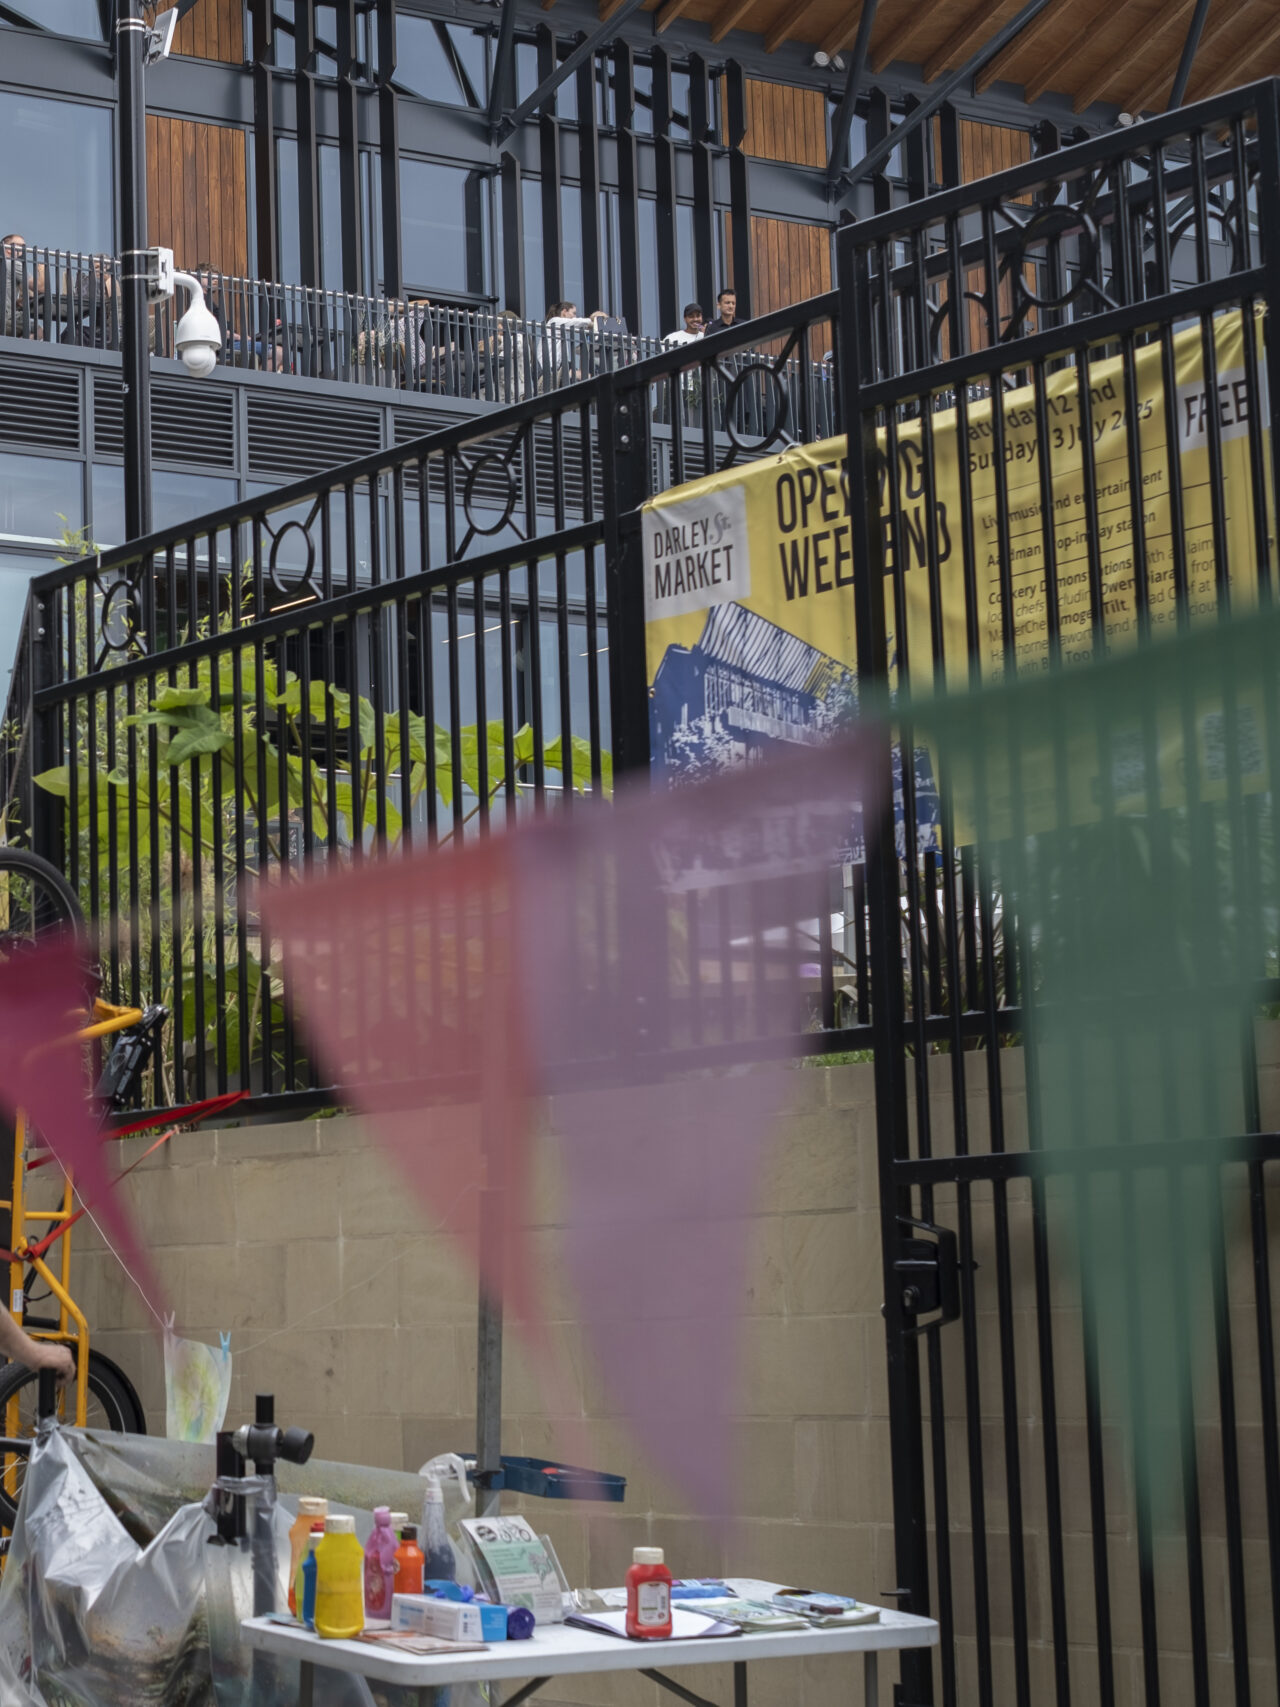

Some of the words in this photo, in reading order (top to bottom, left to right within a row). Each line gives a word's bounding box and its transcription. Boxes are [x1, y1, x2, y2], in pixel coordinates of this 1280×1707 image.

[1075, 378, 1117, 408] nd
[965, 440, 1038, 473] Suday
[1068, 418, 1107, 450] Jy
[1111, 399, 1153, 432] 225
[776, 439, 927, 534] OPEG
[982, 510, 1008, 529] Liv
[1048, 494, 1070, 512] nd
[654, 518, 710, 559] DARLEY
[779, 501, 953, 602] WEEEND
[654, 544, 734, 600] MARKET
